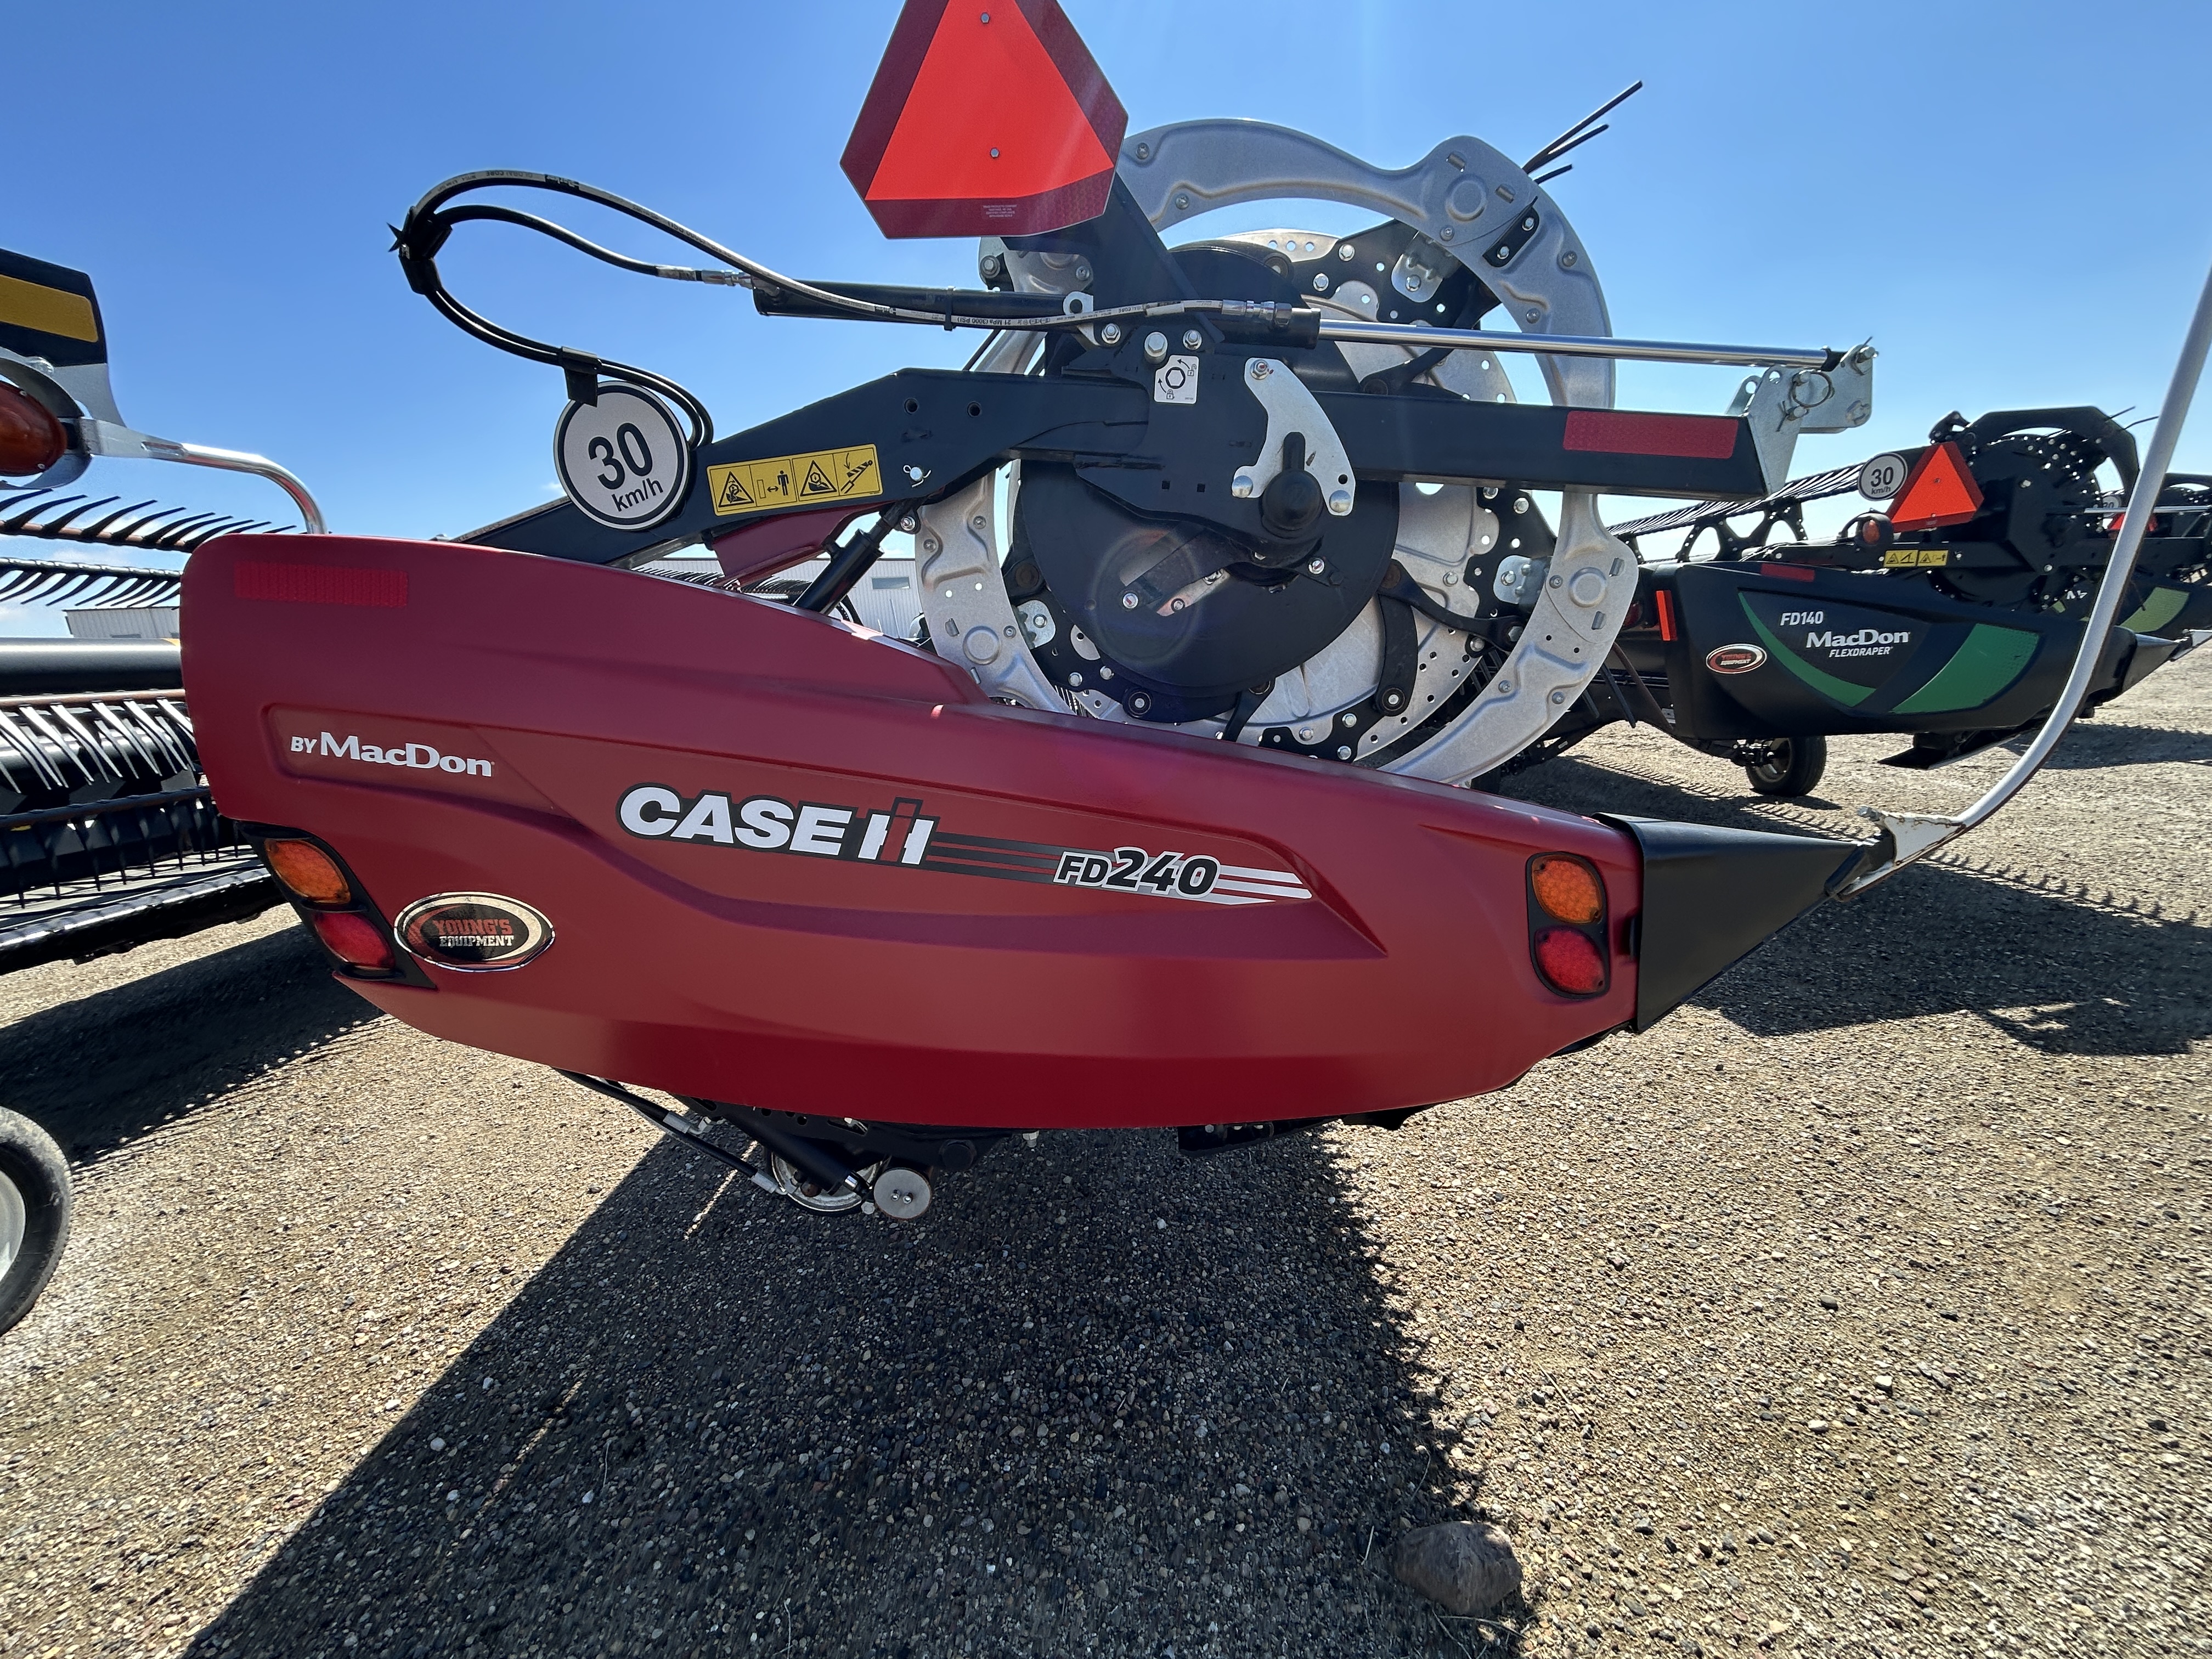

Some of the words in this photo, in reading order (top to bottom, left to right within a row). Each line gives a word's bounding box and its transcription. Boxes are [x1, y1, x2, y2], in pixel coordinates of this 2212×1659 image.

[588, 422, 653, 490] 30
[1870, 466, 1894, 487] 30
[611, 478, 663, 512] km/h
[1871, 486, 1891, 494] km/h
[1780, 611, 1824, 627] FD140
[1805, 629, 1909, 648] MacDon
[1829, 646, 1890, 658] FLEXDRAPER
[290, 736, 317, 753] BY
[320, 731, 493, 777] MacDon
[619, 786, 853, 856] CASE
[1053, 847, 1221, 898] FD240
[432, 918, 513, 935] YOUNG'S
[439, 935, 514, 948] EQUIPMENT
